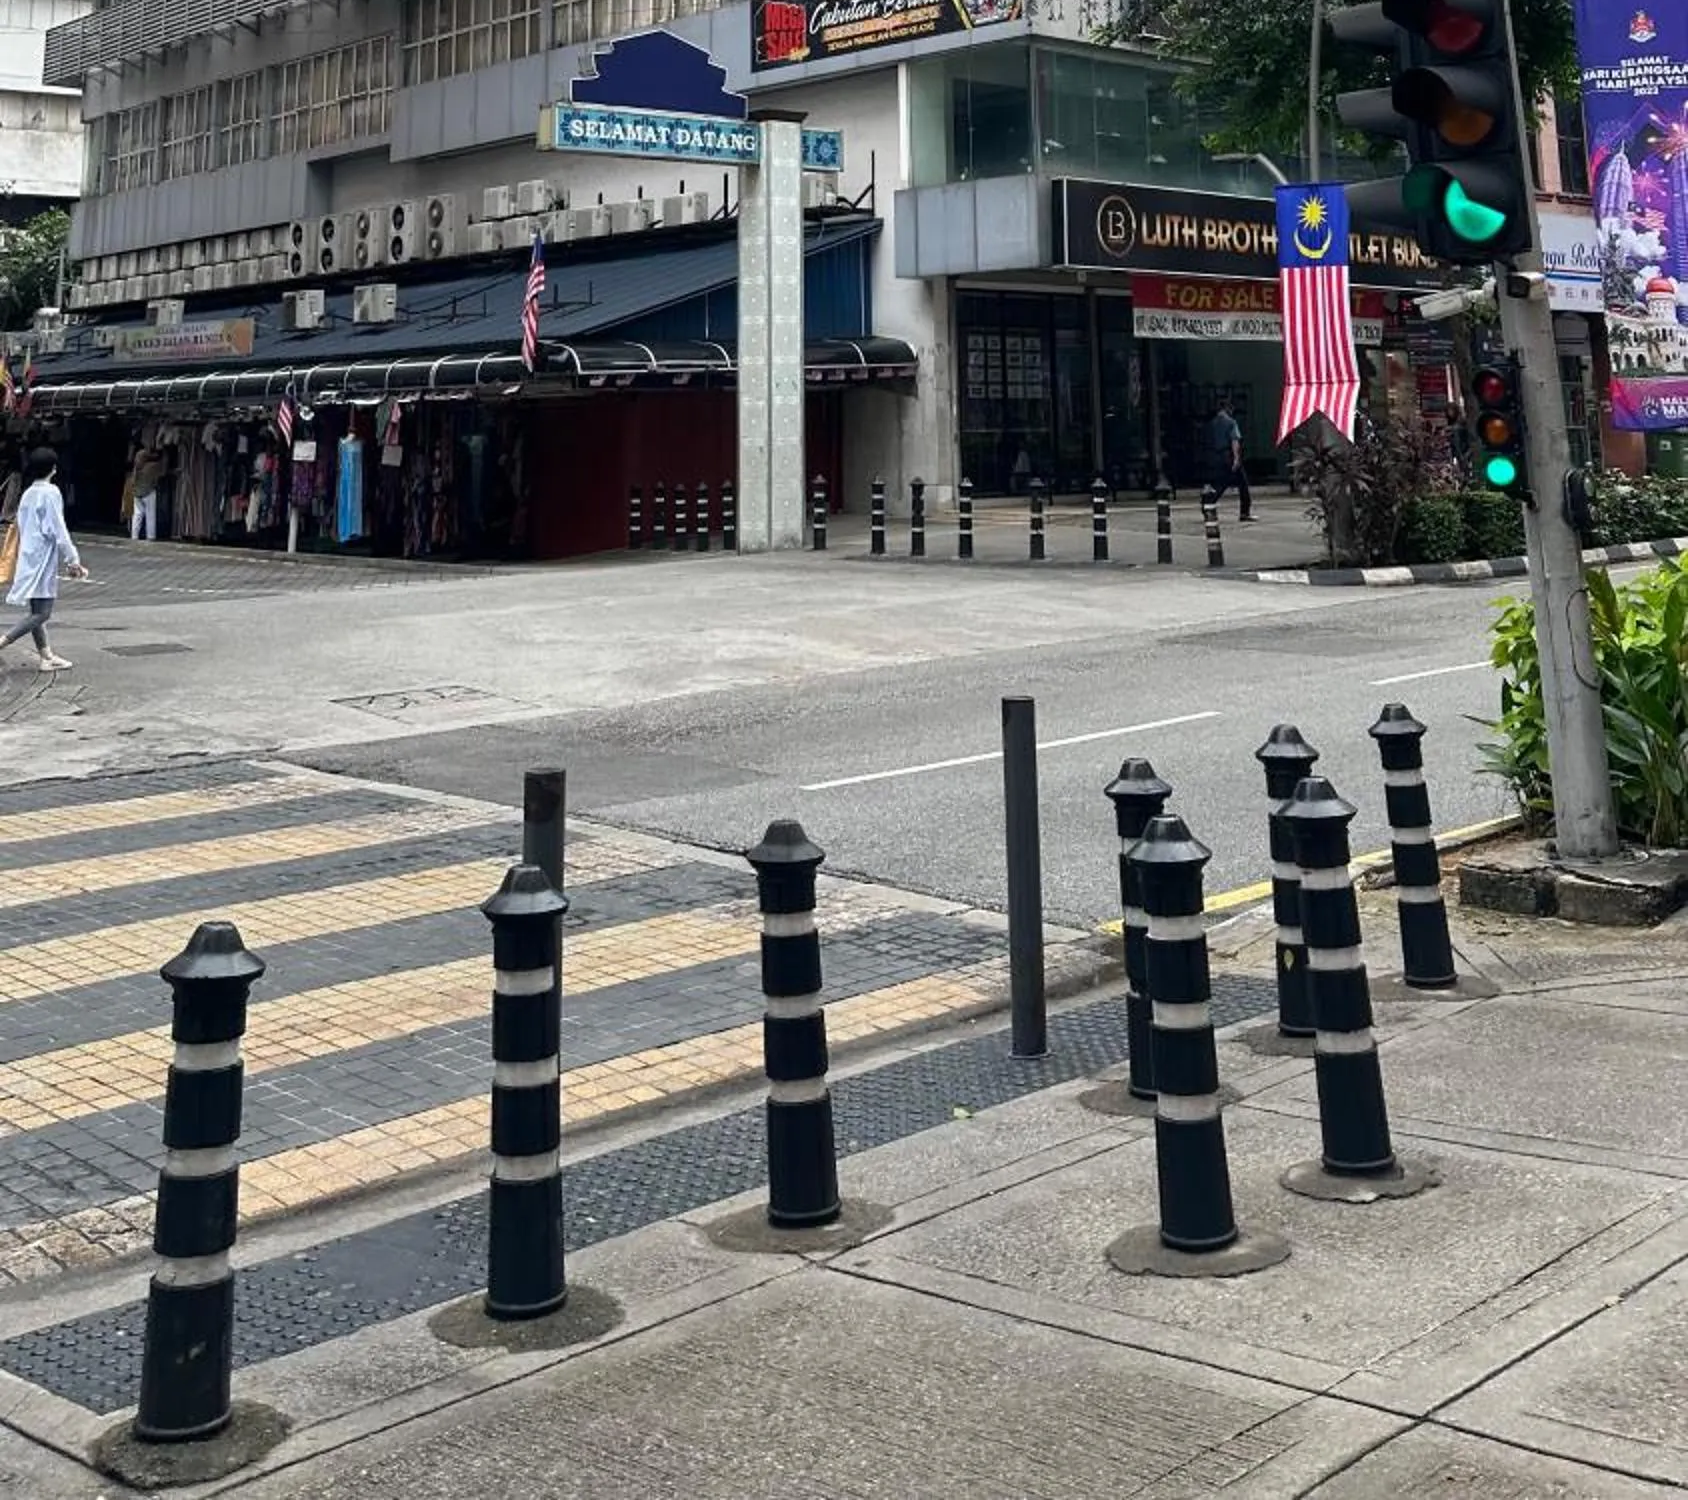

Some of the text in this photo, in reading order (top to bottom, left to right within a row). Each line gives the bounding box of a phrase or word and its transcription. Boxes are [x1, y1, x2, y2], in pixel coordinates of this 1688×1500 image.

[764, 0, 805, 32] MEGA
[765, 30, 807, 60] SALE
[1620, 55, 1669, 67] SELAMAT
[1596, 79, 1627, 89] HARI
[570, 118, 756, 151] SELAMAT DATANG
[1140, 212, 1199, 247] LUTH
[1201, 218, 1278, 256] BROTH
[1349, 232, 1389, 265] TLET
[1165, 283, 1274, 309] FOR SALE
